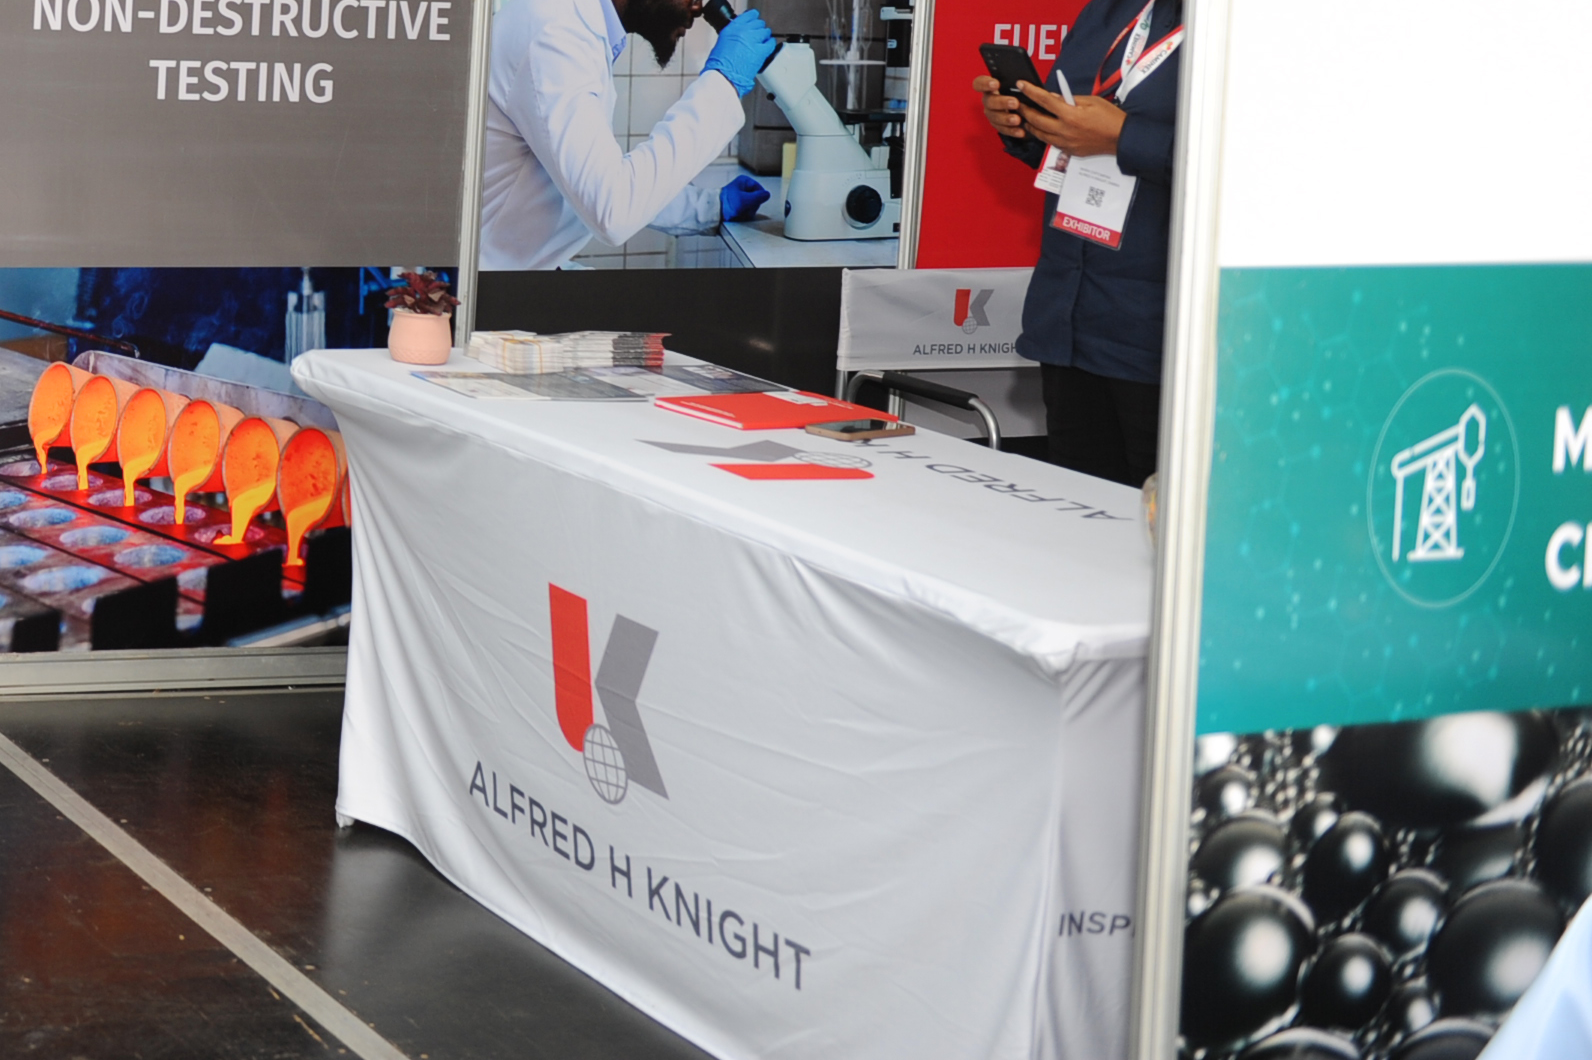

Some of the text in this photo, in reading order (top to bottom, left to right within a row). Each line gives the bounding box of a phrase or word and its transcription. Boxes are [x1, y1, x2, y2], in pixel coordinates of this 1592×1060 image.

[149, 59, 335, 104] TESTING
[1062, 216, 1111, 241] EXHIBITOR
[912, 342, 1017, 355] ALFRED H KNIGH
[925, 463, 1135, 522] ALFRED
[469, 759, 812, 991] ALFRED H KNIGHT
[1058, 910, 1136, 938] INSP
